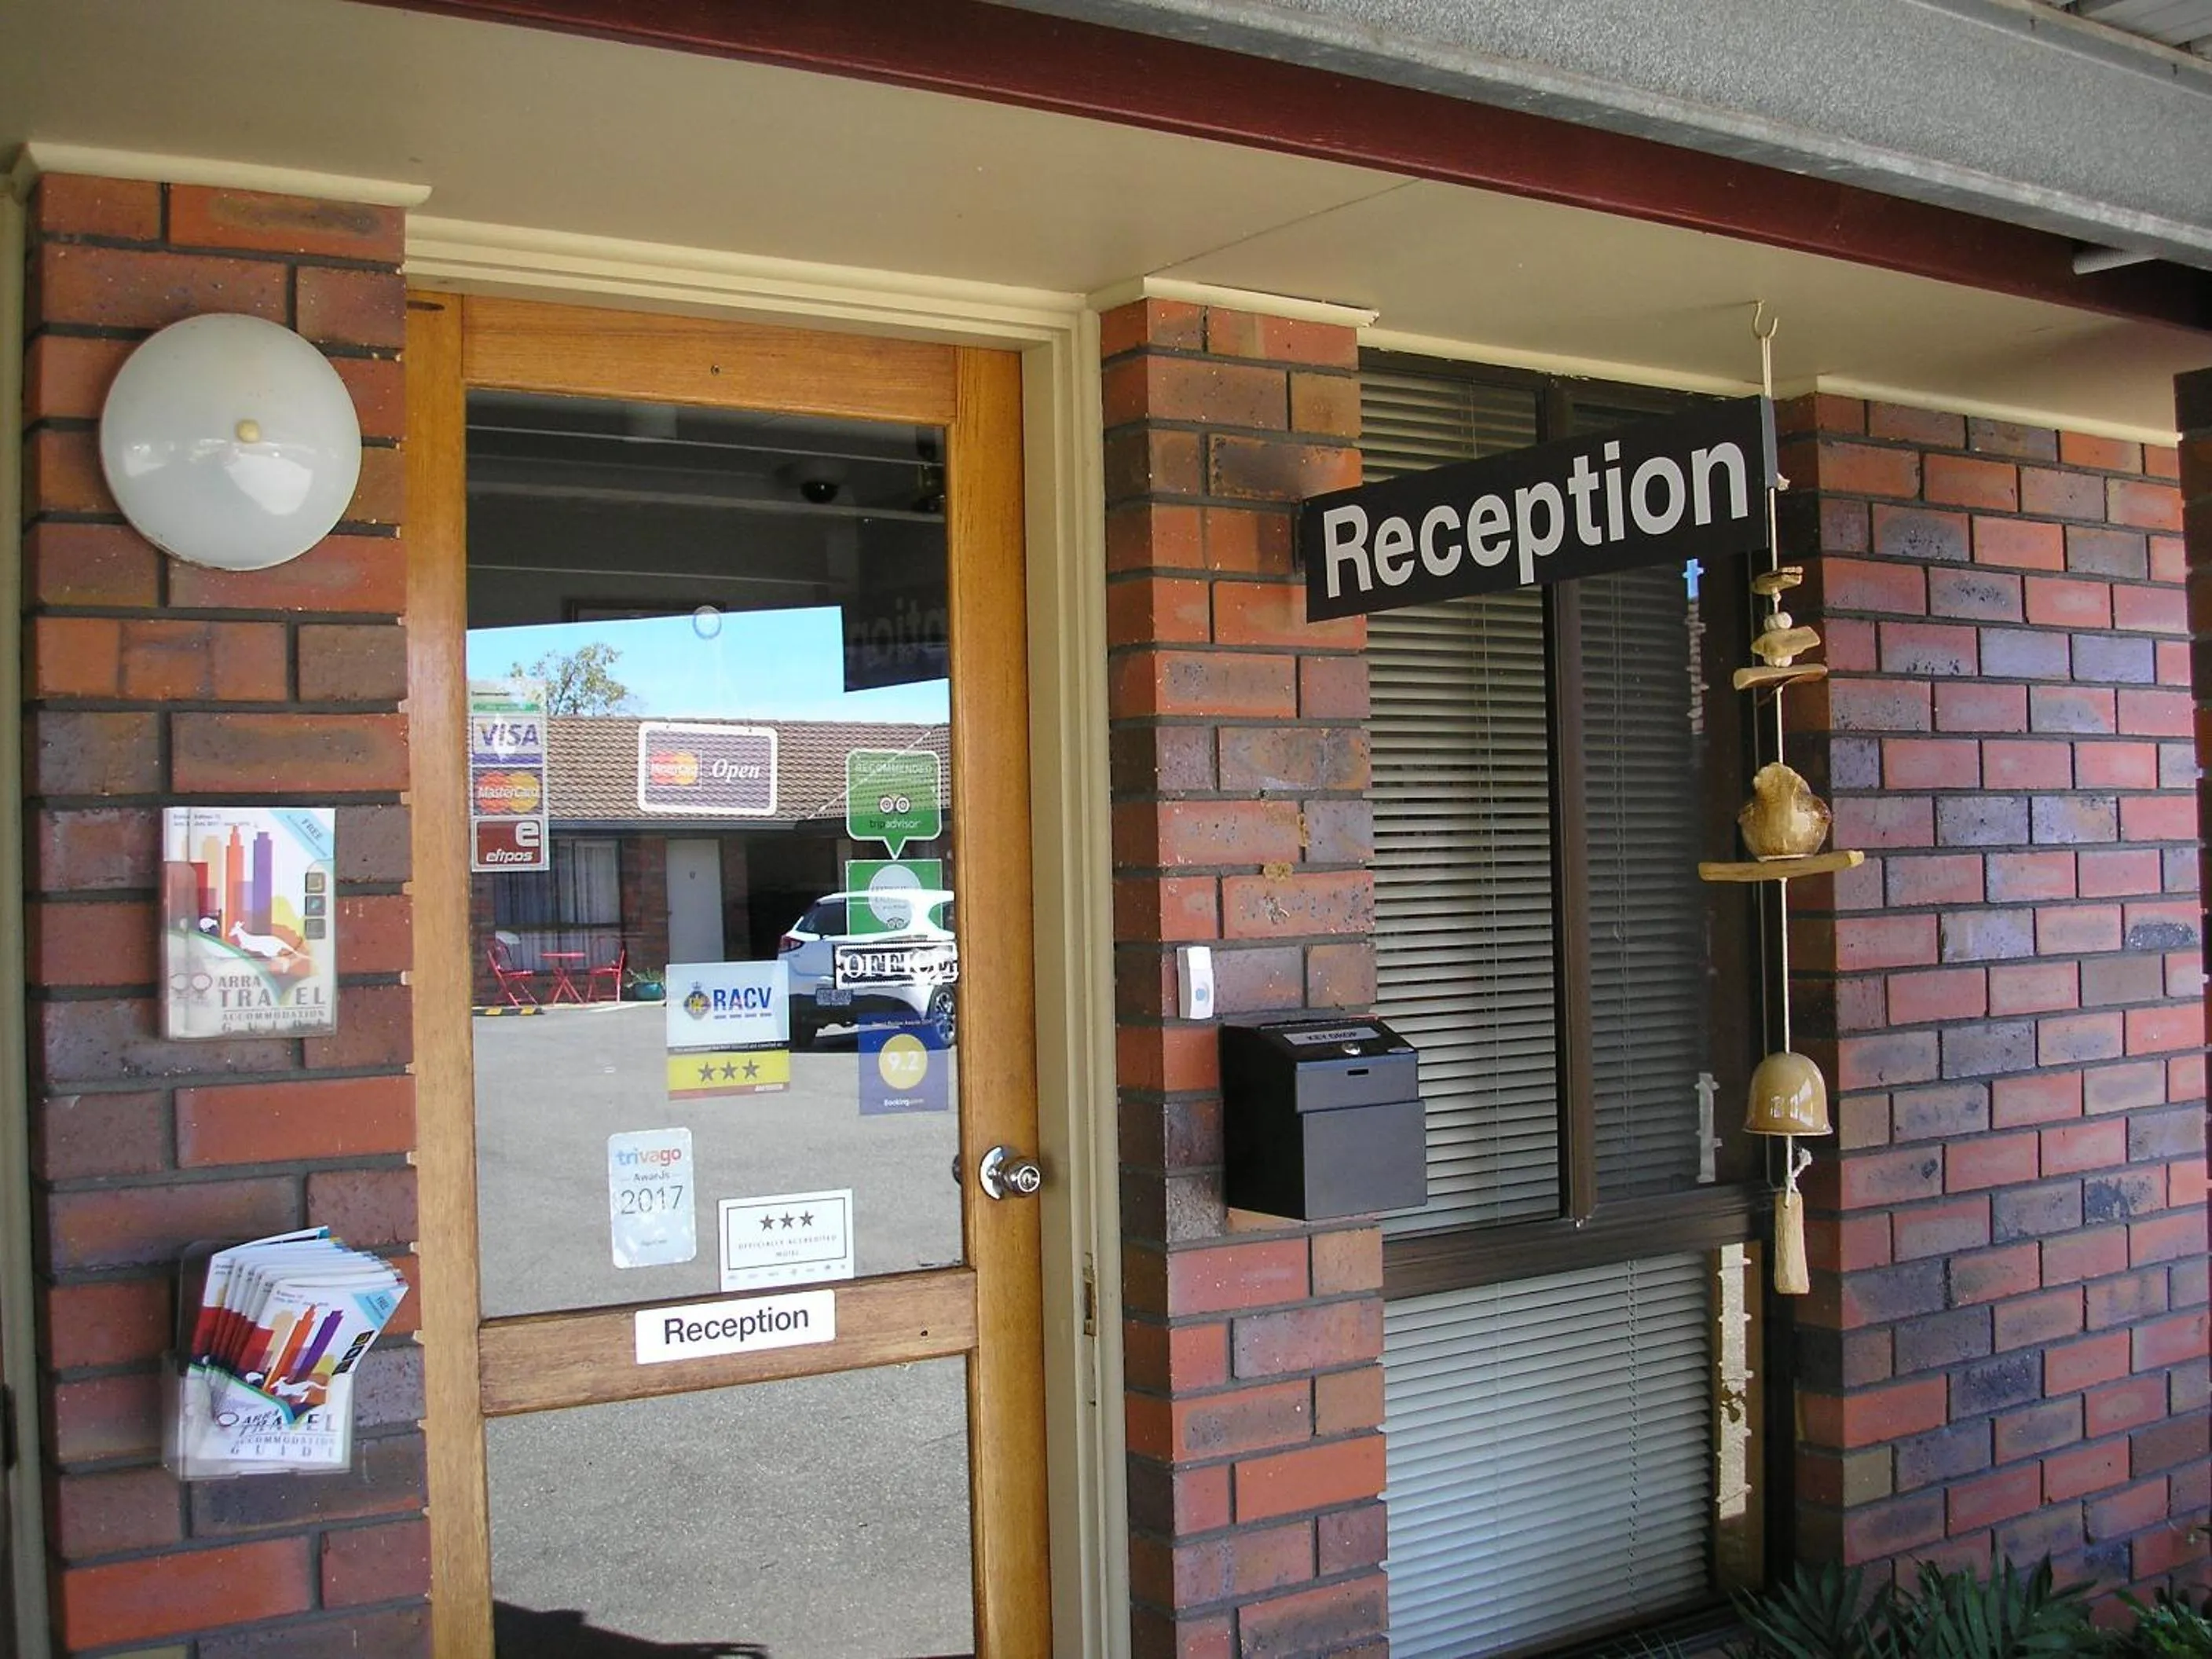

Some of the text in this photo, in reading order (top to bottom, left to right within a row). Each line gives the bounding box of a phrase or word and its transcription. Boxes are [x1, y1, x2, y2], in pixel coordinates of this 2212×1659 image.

[1323, 440, 1749, 599] Reception
[477, 723, 539, 746] VISA
[712, 758, 760, 783] Open
[302, 818, 323, 840] FREE
[485, 848, 533, 864] eftpos
[712, 986, 772, 1012] RACV
[888, 1050, 919, 1071] 9.2
[615, 1147, 683, 1166] trivago
[633, 1170, 670, 1182] Awards
[621, 1185, 683, 1214] 2017
[664, 1306, 809, 1345] Reception
